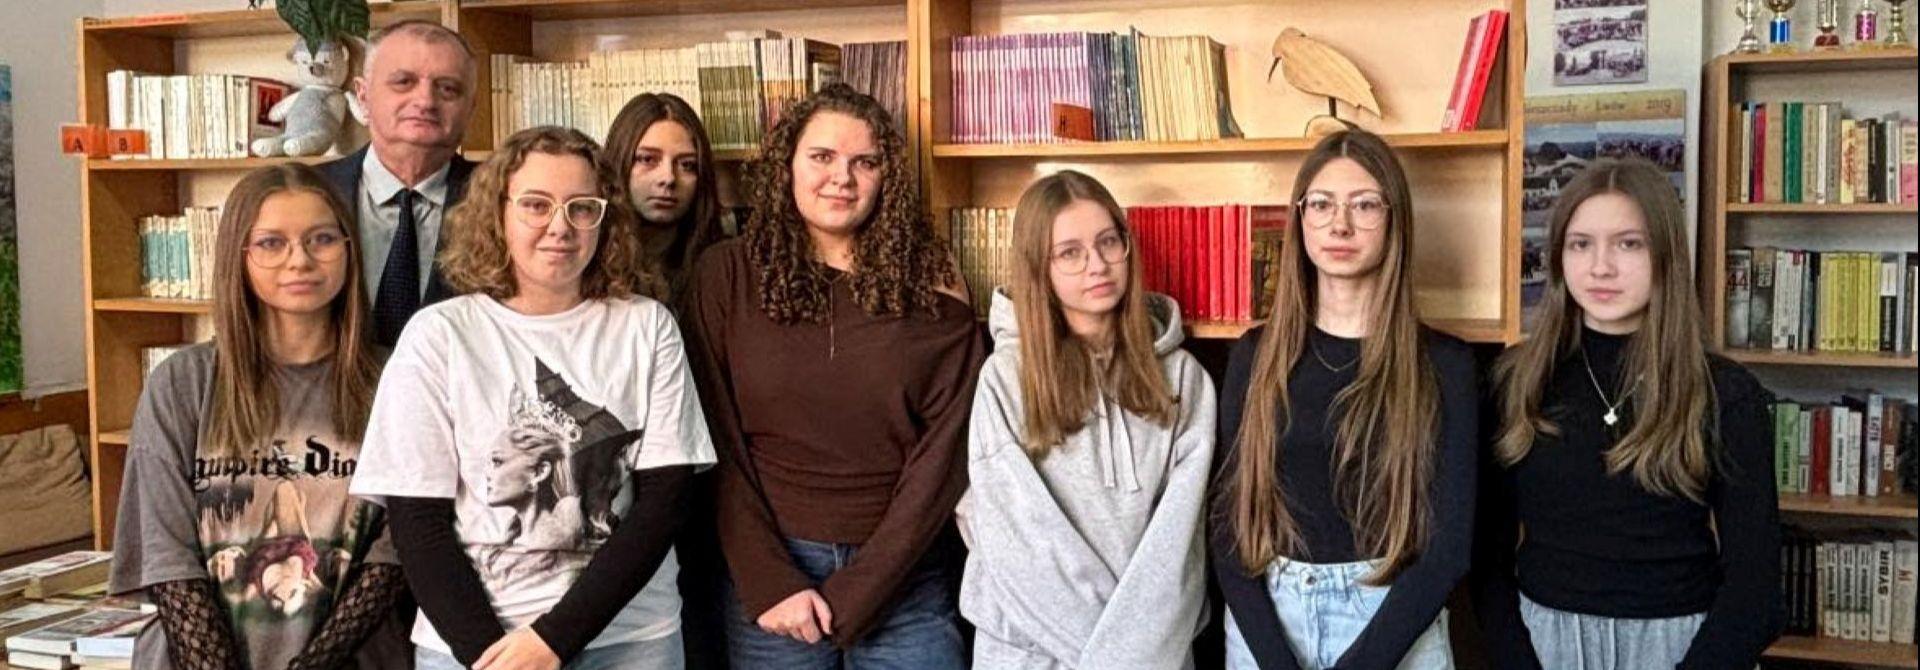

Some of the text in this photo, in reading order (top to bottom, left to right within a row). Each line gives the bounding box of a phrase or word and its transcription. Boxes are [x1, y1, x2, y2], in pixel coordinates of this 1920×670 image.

[74, 137, 84, 152] A
[119, 137, 128, 152] B
[304, 435, 357, 478] Dia
[1878, 550, 1890, 596] SYBIR
